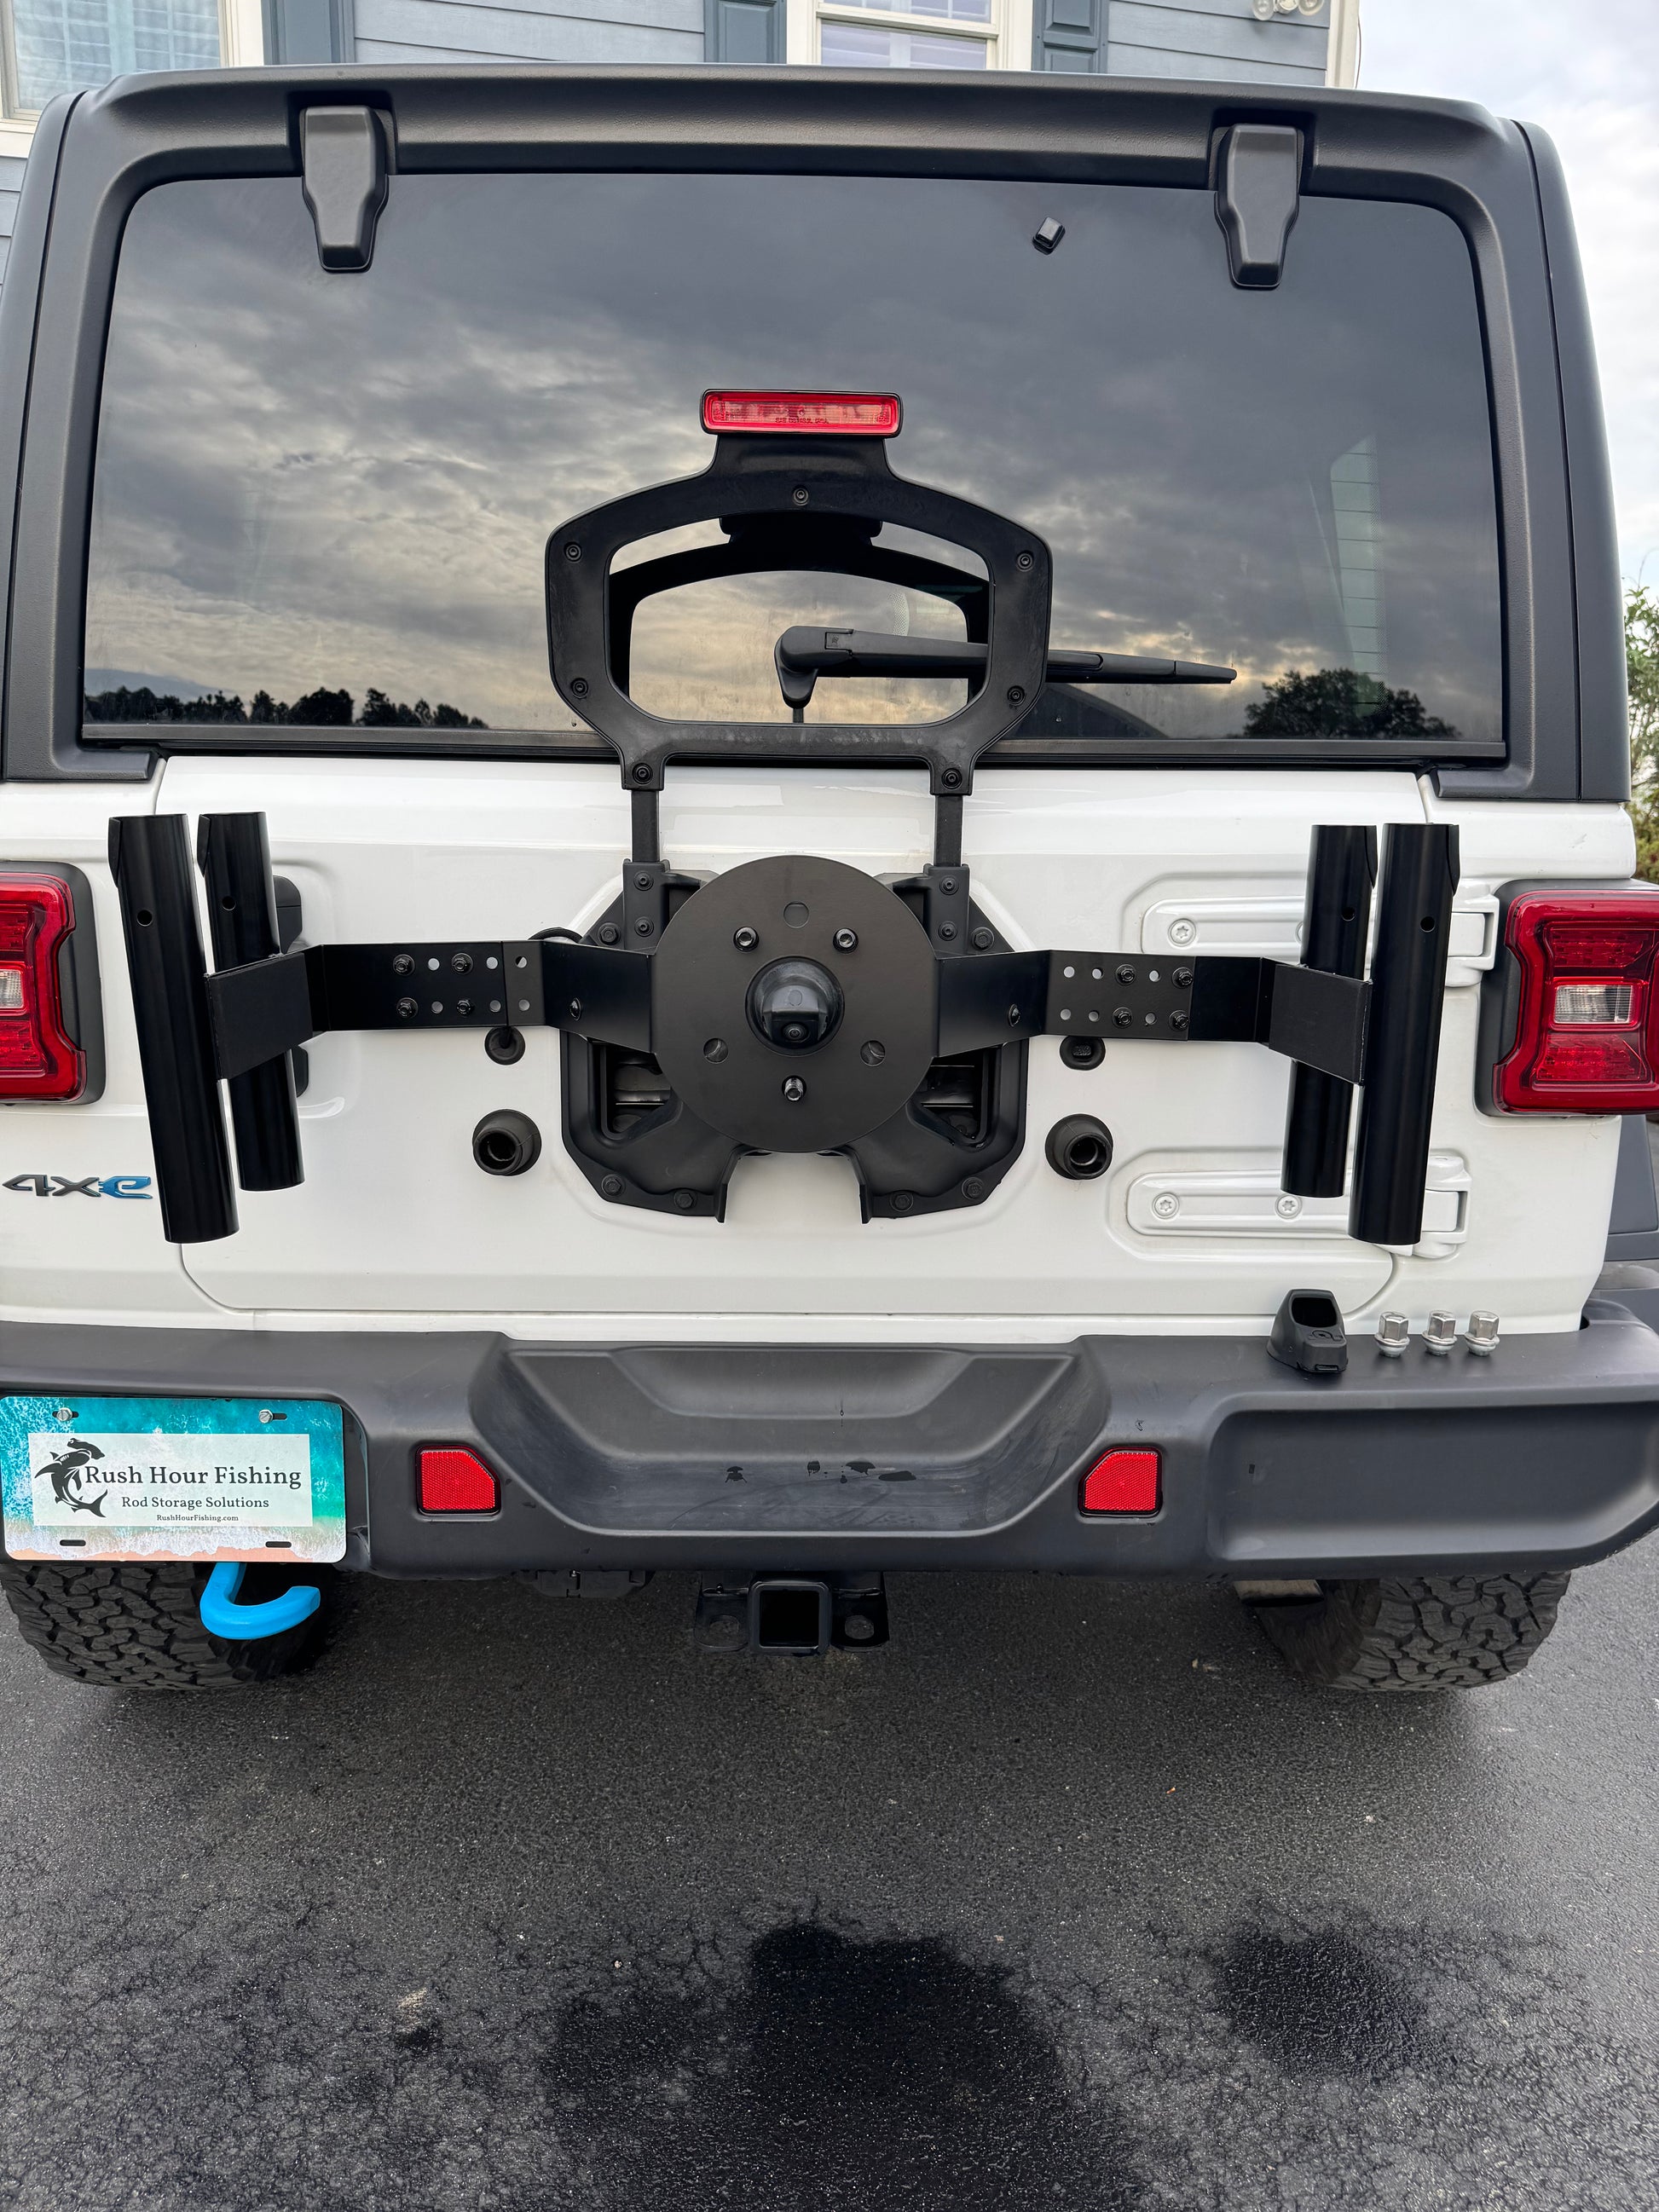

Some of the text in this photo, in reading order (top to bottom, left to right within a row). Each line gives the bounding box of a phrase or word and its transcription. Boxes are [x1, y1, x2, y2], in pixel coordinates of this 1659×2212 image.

[84, 1465, 302, 1490] Rush Hour Fishing
[121, 1496, 269, 1511] Rod Storage Solutions
[156, 1513, 239, 1523] RushHourFishing.com
